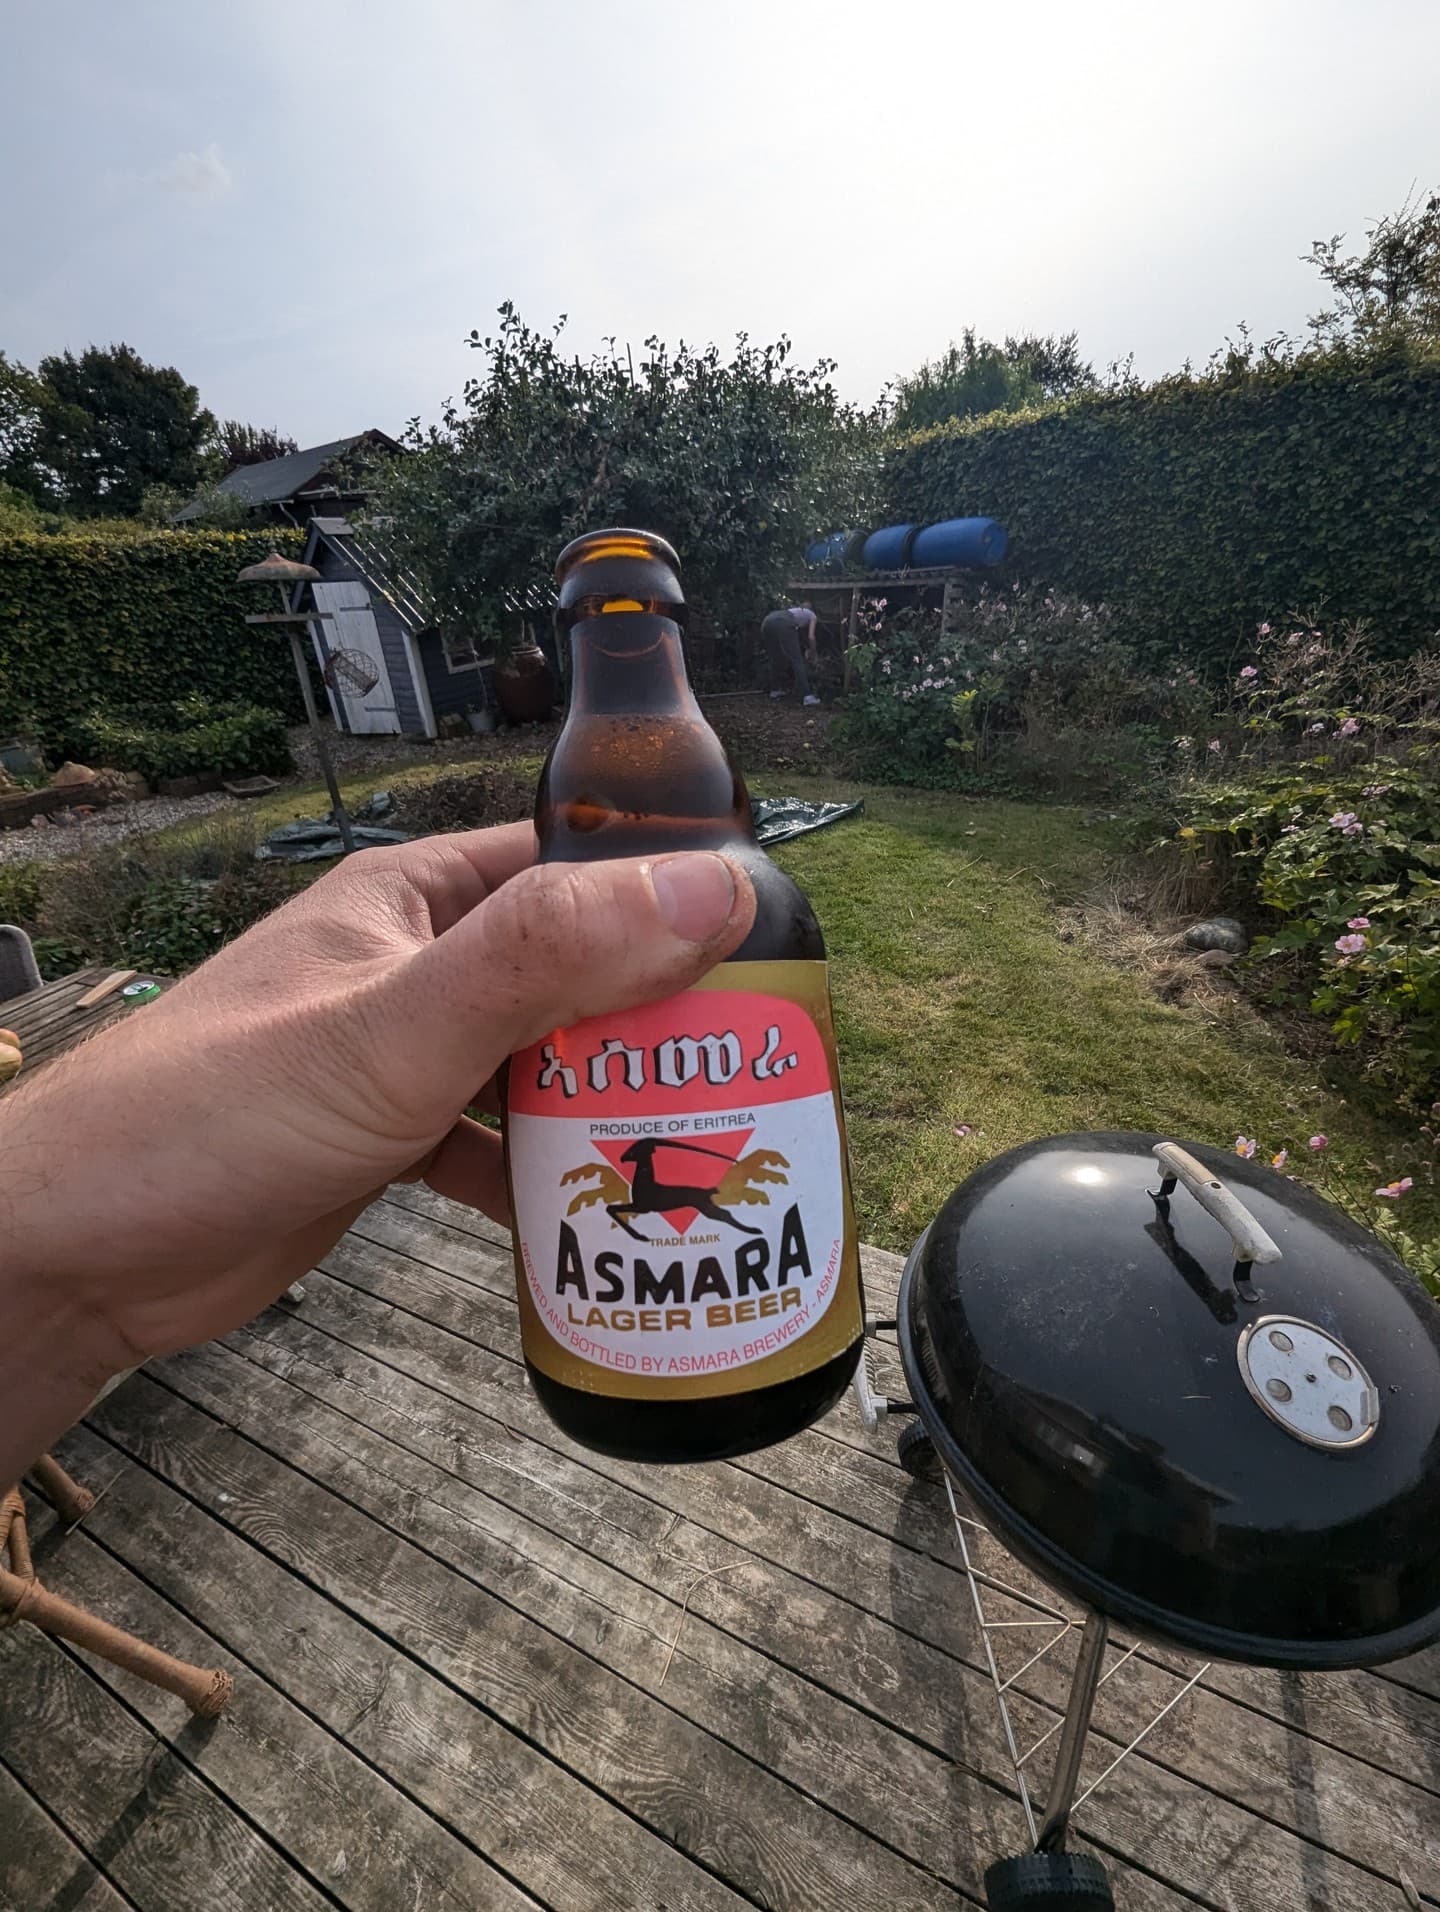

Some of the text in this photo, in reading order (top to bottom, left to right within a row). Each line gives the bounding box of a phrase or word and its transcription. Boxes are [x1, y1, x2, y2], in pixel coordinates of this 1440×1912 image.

[590, 1112, 756, 1136] PRODUCE OF ERITREA
[556, 1202, 812, 1305] ASMARA
[650, 1233, 721, 1247] TRADE MARK
[521, 1241, 548, 1309] BREWED
[546, 1308, 569, 1336] AND
[570, 1331, 637, 1370] BOTTLED
[641, 1356, 664, 1373] BY
[667, 1348, 741, 1373] ASMARA
[743, 1305, 811, 1360] BREWERY
[816, 1239, 841, 1302] ASMARA
[568, 1286, 802, 1332] LAGER BEER
